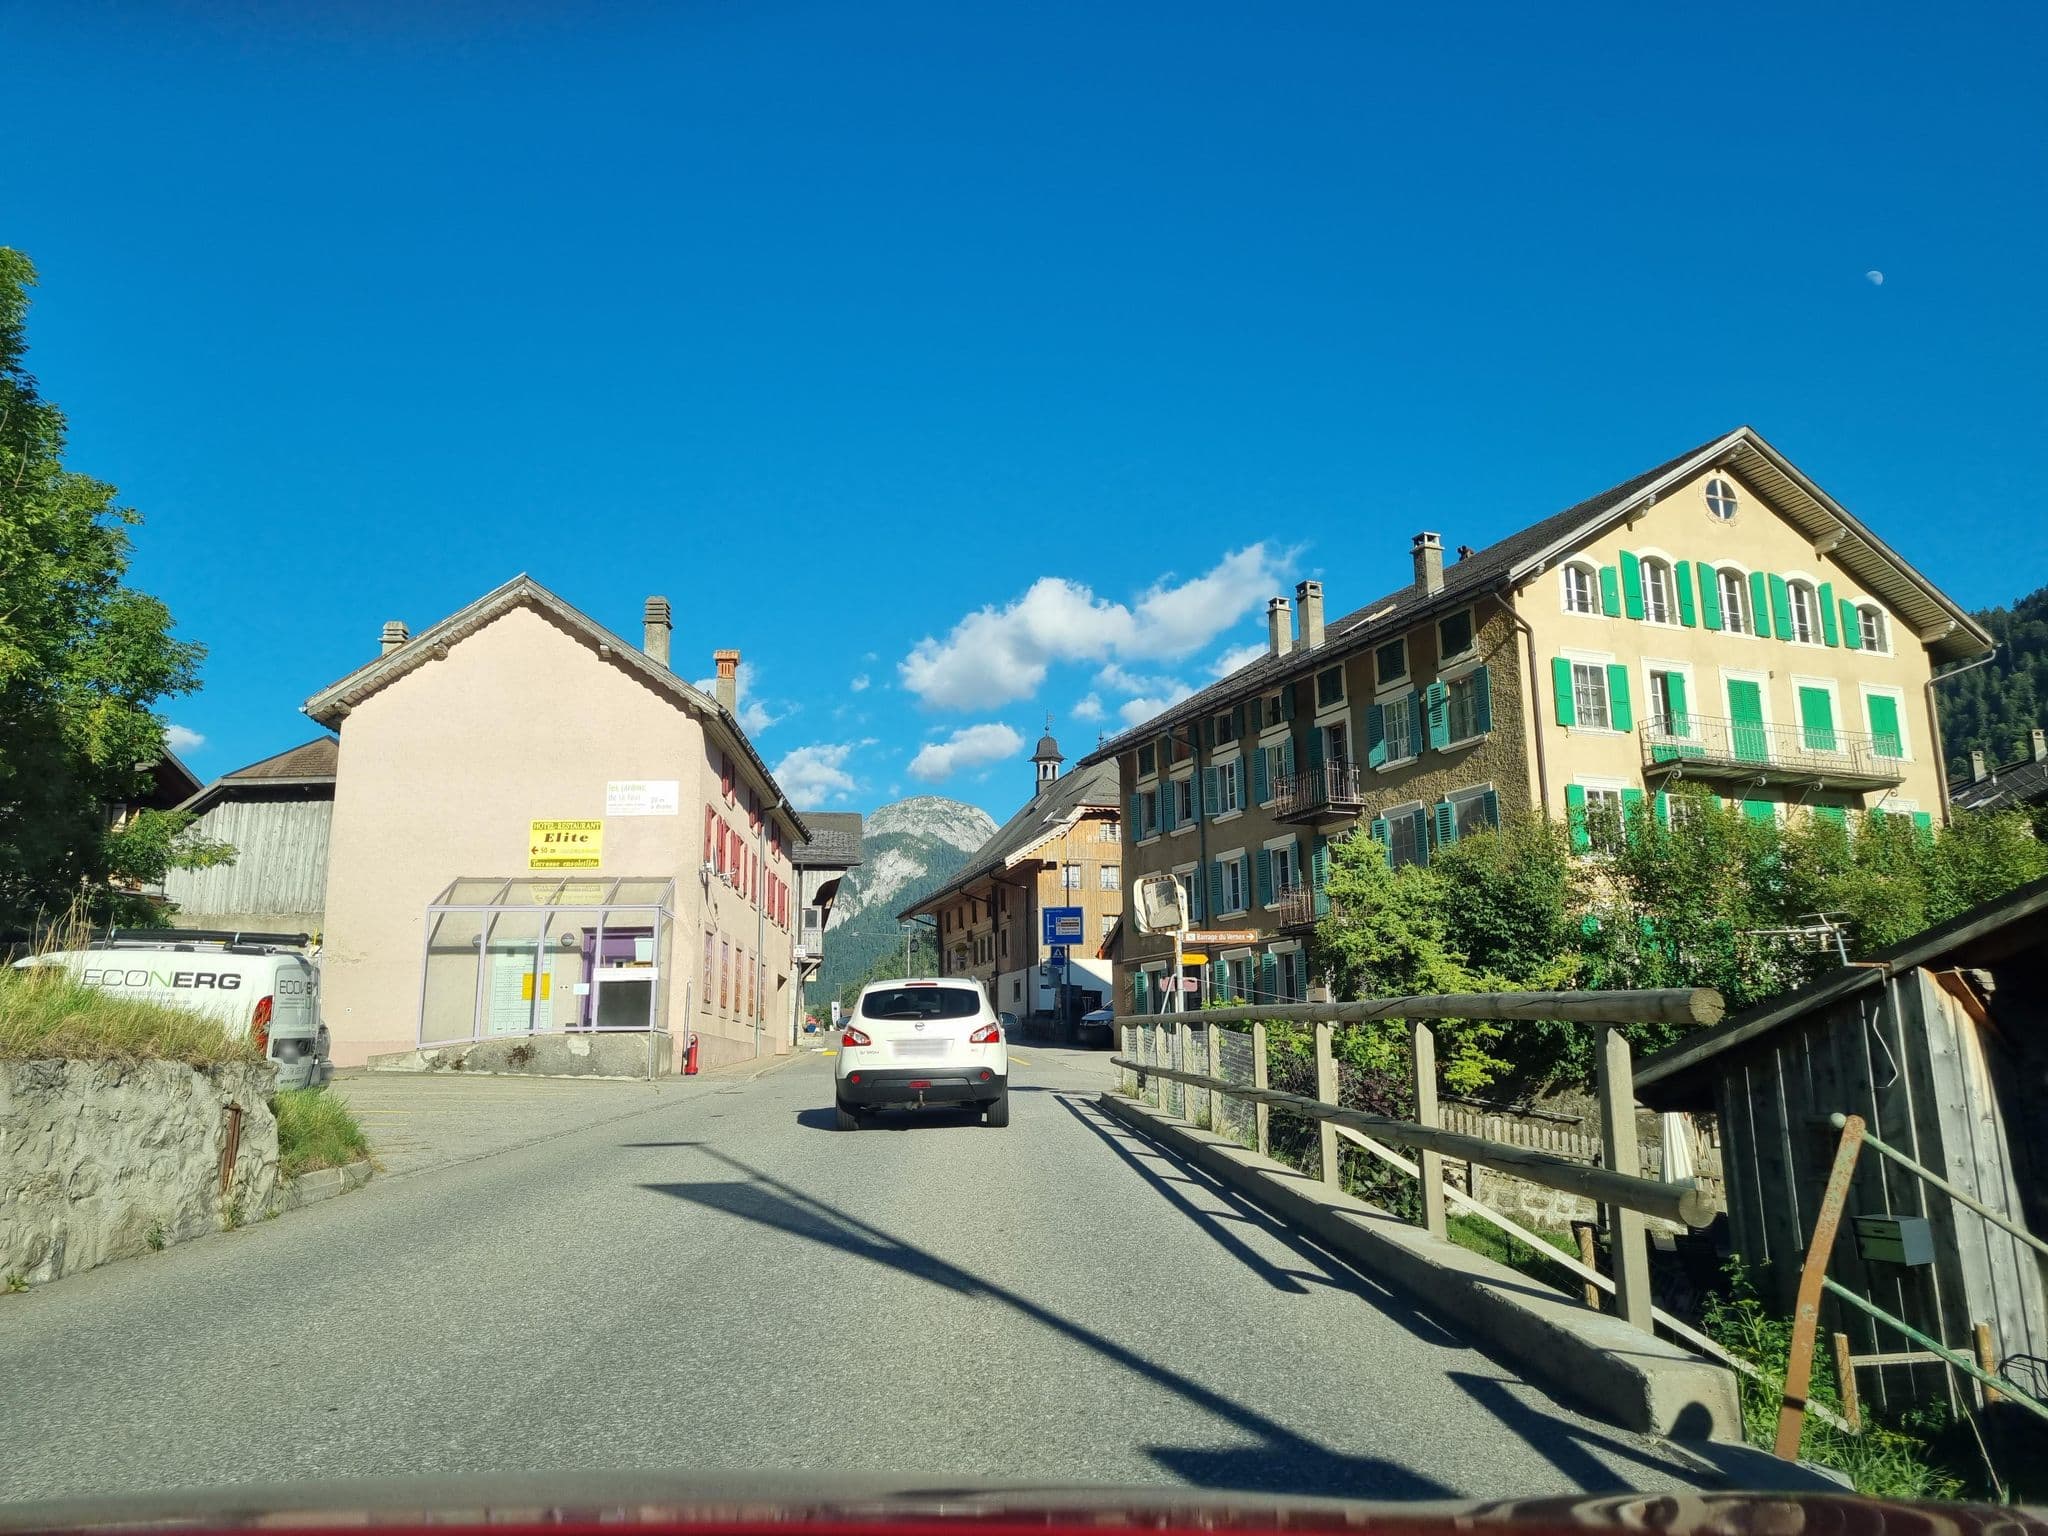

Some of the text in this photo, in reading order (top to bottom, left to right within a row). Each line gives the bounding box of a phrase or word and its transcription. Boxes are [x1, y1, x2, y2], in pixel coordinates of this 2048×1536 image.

[544, 832, 589, 843] Elite
[1196, 933, 1218, 942] Barrage
[82, 968, 242, 990] ECONERG
